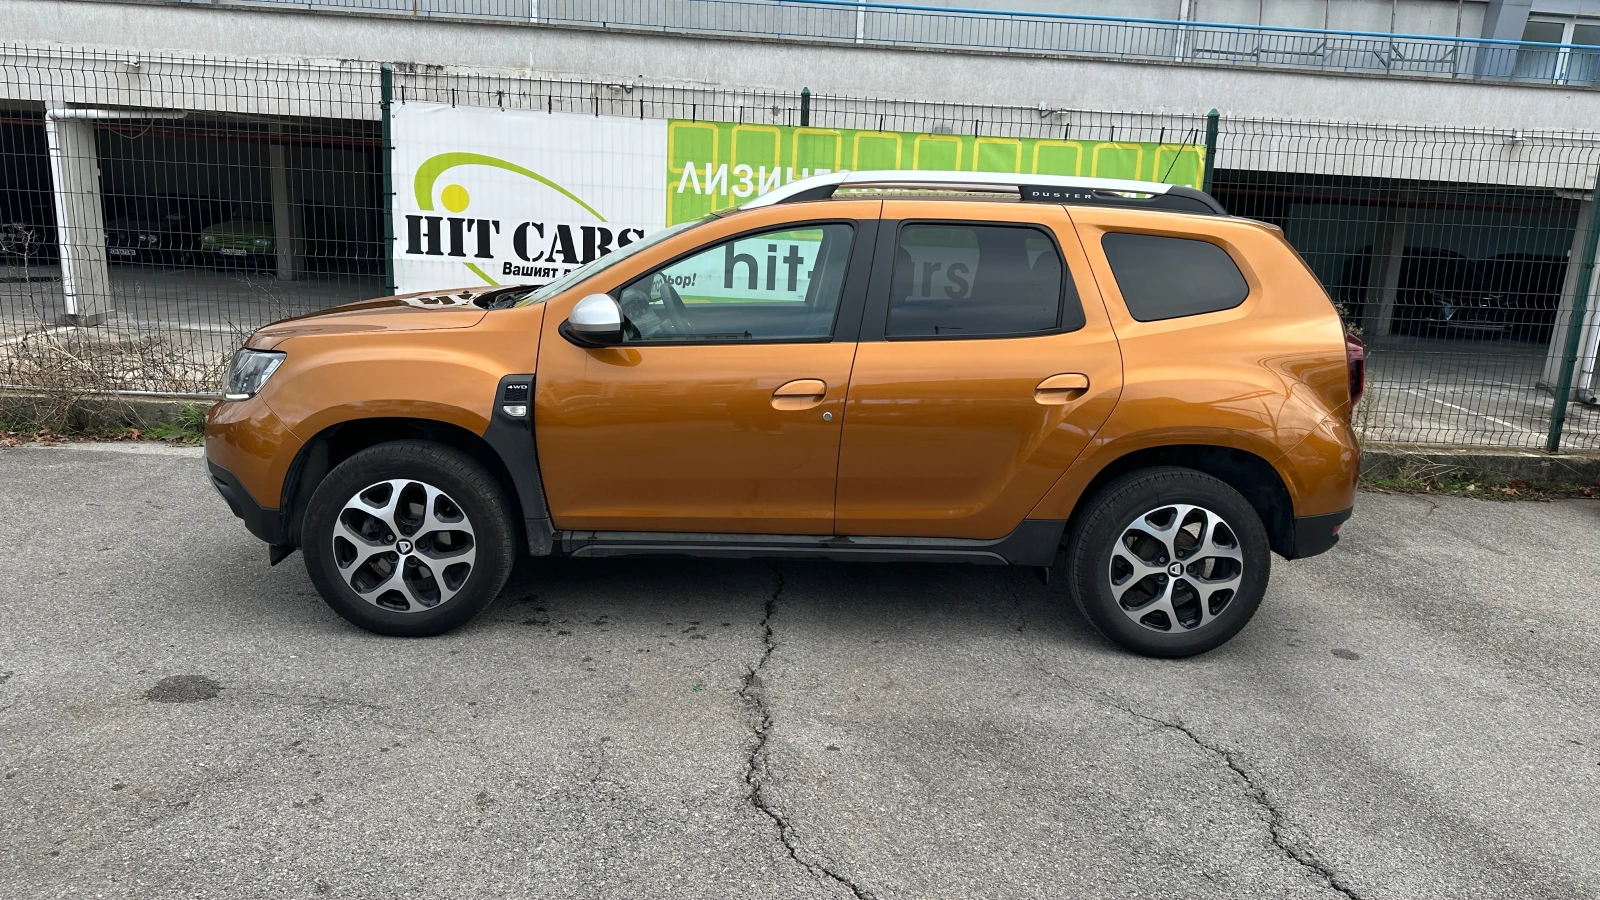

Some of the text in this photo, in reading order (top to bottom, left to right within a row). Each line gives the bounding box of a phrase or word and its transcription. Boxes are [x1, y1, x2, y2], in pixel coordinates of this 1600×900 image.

[676, 161, 831, 197] ЛИЗИ
[1032, 191, 1092, 200] DUSTER
[405, 214, 500, 259] HIT
[502, 261, 559, 278] Вашият
[908, 261, 970, 300] rs
